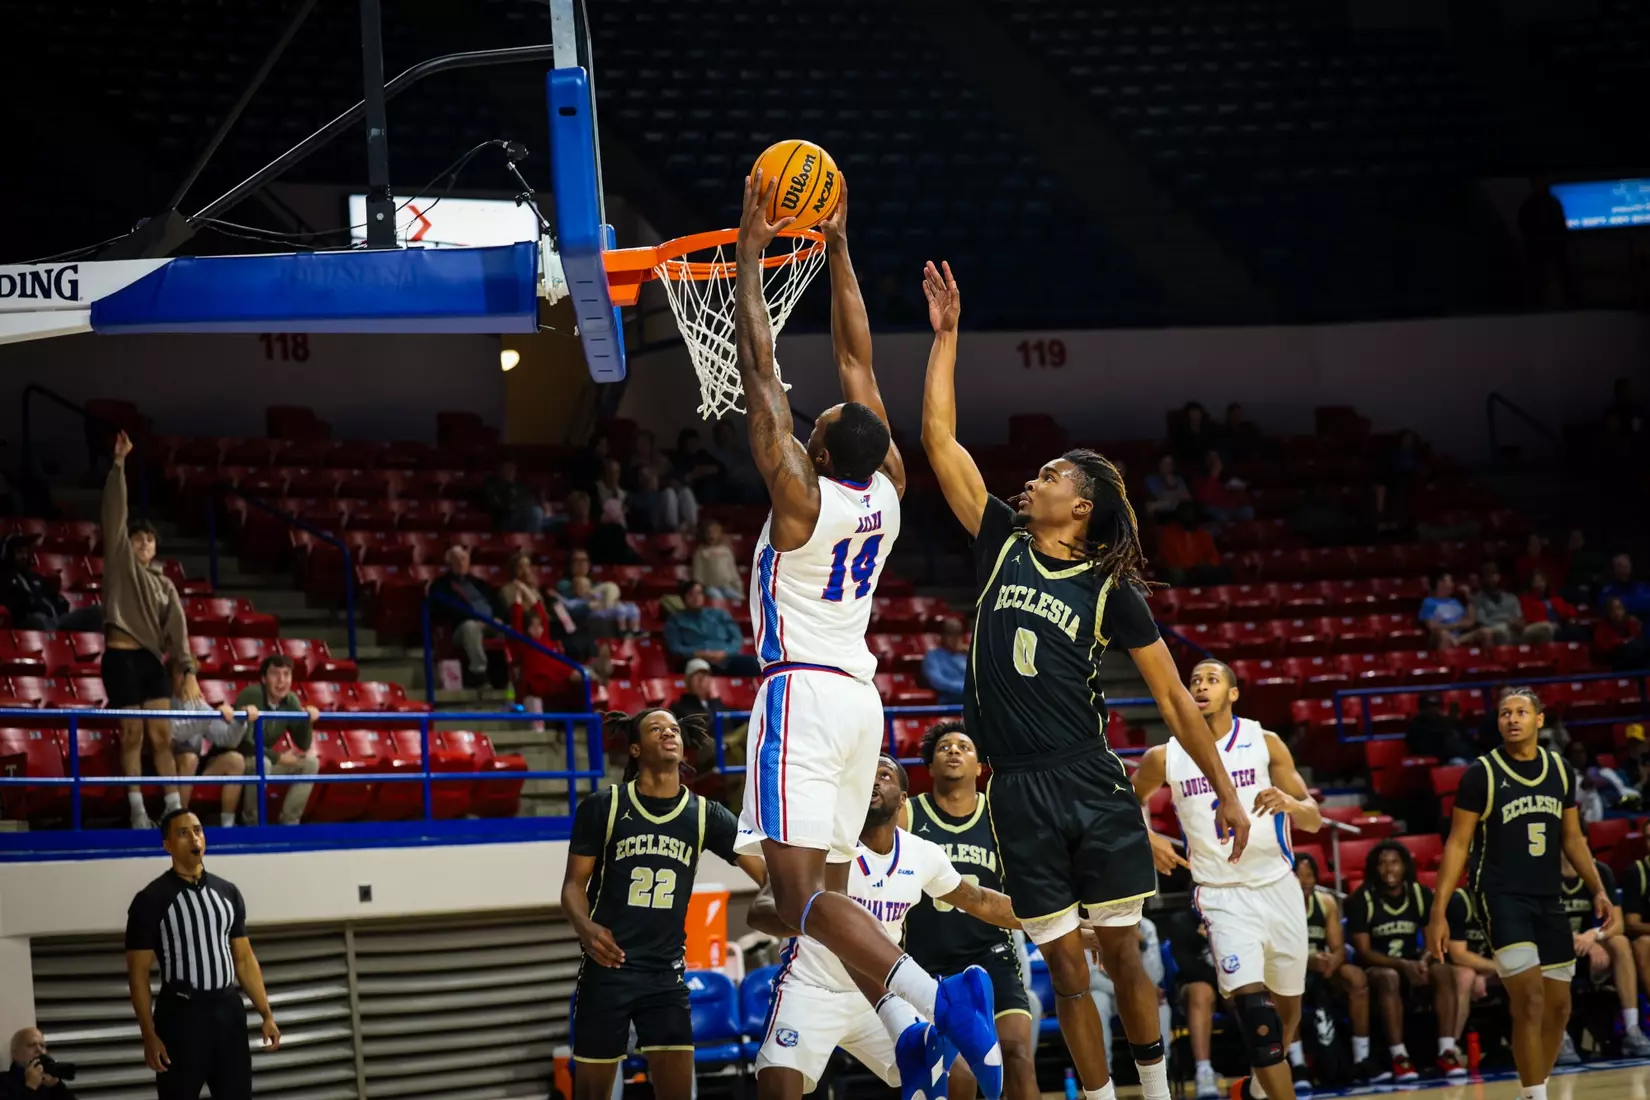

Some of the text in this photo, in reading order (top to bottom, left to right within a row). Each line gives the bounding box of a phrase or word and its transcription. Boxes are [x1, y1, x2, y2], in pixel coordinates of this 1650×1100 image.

[781, 154, 816, 210] Wilson
[812, 171, 834, 213] NCAA
[0, 264, 79, 301] DING
[259, 332, 309, 363] 118
[1016, 338, 1066, 368] 119
[821, 533, 885, 602] 14
[993, 584, 1081, 642] ECCLESIA
[1013, 626, 1038, 678] 0
[1180, 768, 1256, 797] LOUIS TECH
[1501, 795, 1563, 825] ECCLESIA
[615, 834, 693, 868] ECCLESIA
[1527, 822, 1546, 857] 5
[938, 843, 997, 873] LESIA
[627, 866, 677, 909] 22
